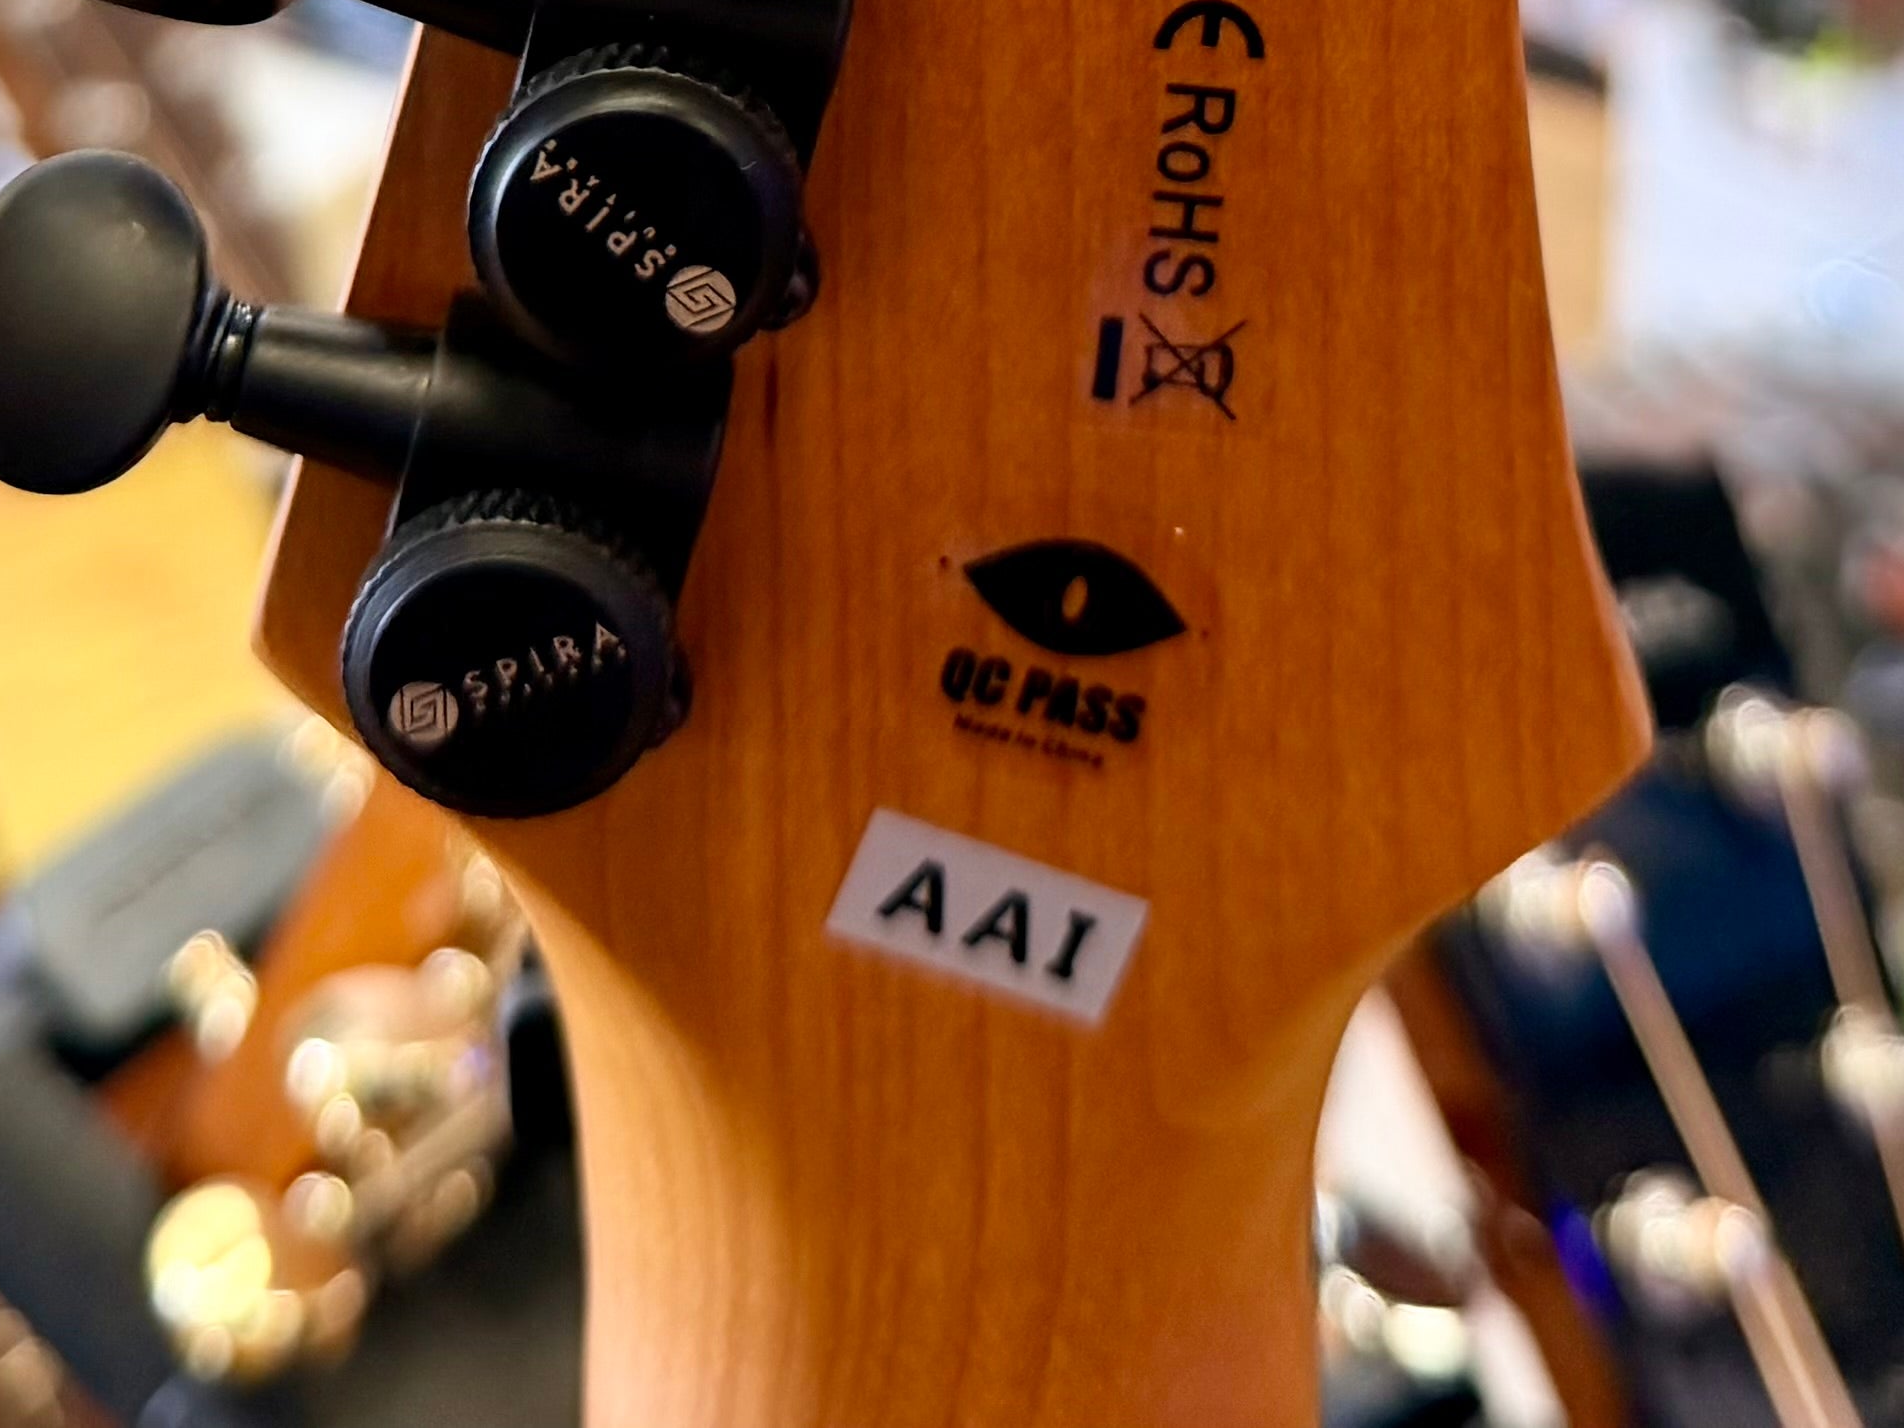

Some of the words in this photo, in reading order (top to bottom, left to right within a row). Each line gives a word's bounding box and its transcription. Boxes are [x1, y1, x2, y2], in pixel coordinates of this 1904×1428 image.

[530, 150, 666, 280] SPIRA
[1143, 82, 1236, 298] RoHS
[462, 621, 620, 699] SPIRA
[940, 646, 1011, 706] QC
[1017, 665, 1147, 744] PASS
[876, 857, 1099, 982] AAI
